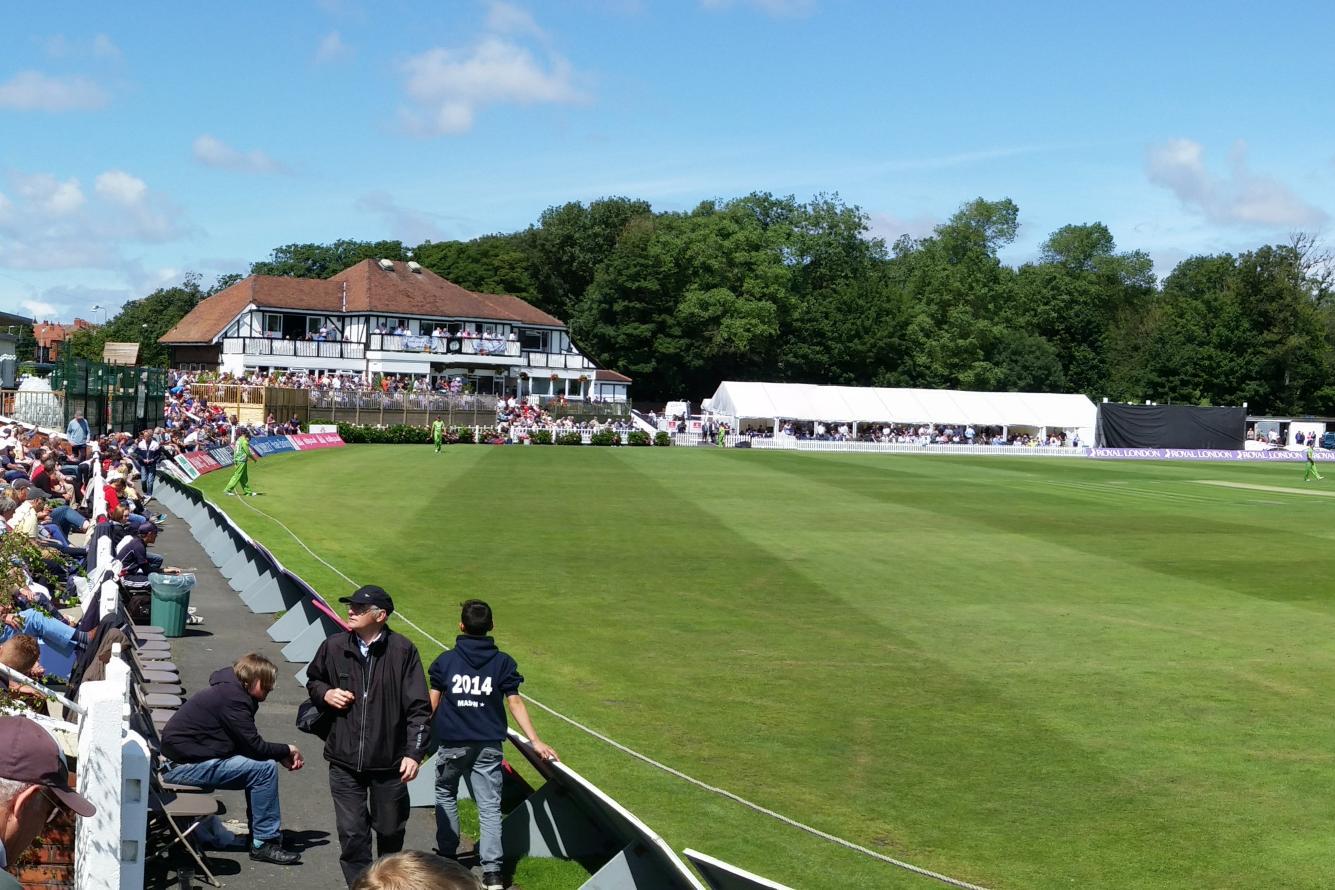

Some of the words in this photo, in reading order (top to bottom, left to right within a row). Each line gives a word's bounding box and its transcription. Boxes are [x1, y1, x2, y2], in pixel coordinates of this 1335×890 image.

[1097, 449, 1124, 457] ROYAL
[1125, 449, 1160, 457] LONDON
[1171, 450, 1197, 458] ROYAL
[1198, 450, 1233, 458] LONDON
[1242, 451, 1267, 459] ROYAL
[1268, 451, 1303, 459] LONDON
[1312, 451, 1335, 459] ROYAL
[452, 674, 493, 696] 2014
